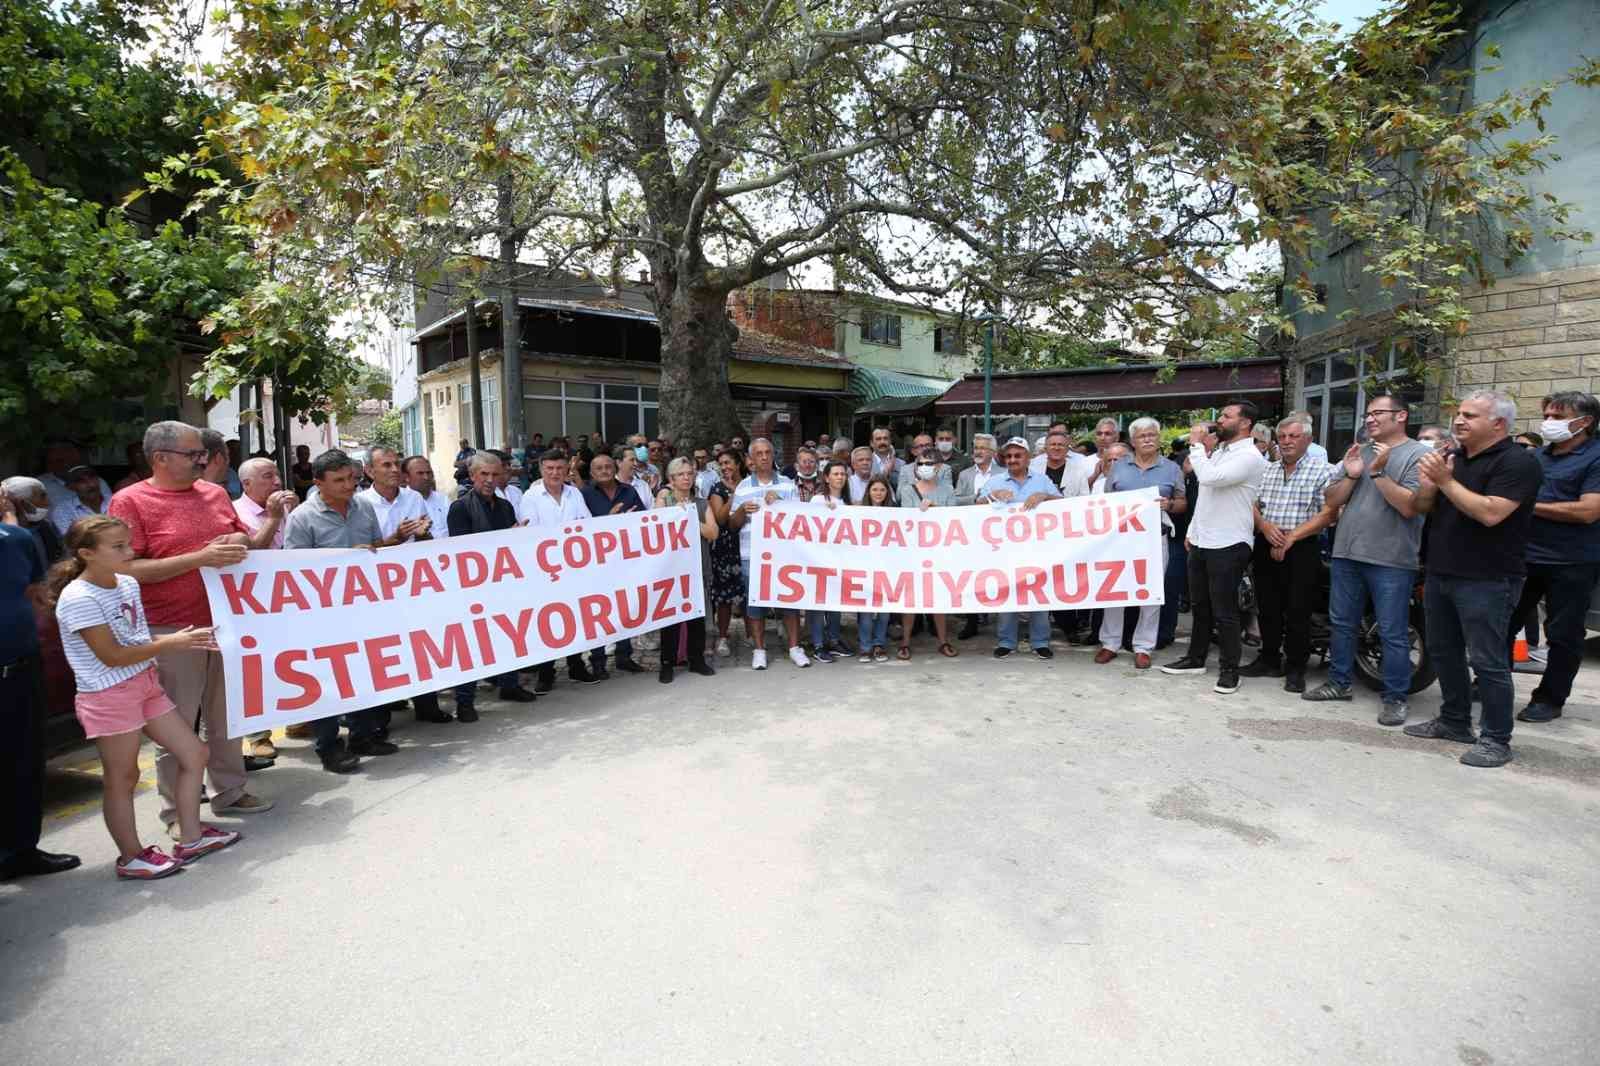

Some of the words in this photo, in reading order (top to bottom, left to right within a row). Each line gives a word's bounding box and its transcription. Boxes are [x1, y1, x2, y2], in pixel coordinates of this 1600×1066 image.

[220, 546, 524, 616] KAYAPA’DA
[536, 515, 691, 582] ÇÖPLÜK
[762, 511, 969, 548] KAYAPA’DA
[980, 502, 1147, 552] ÇÖPLÜK
[759, 551, 1151, 609] İSTEMİYORUZ!
[240, 574, 693, 719] İSTEMİYORUZ!
